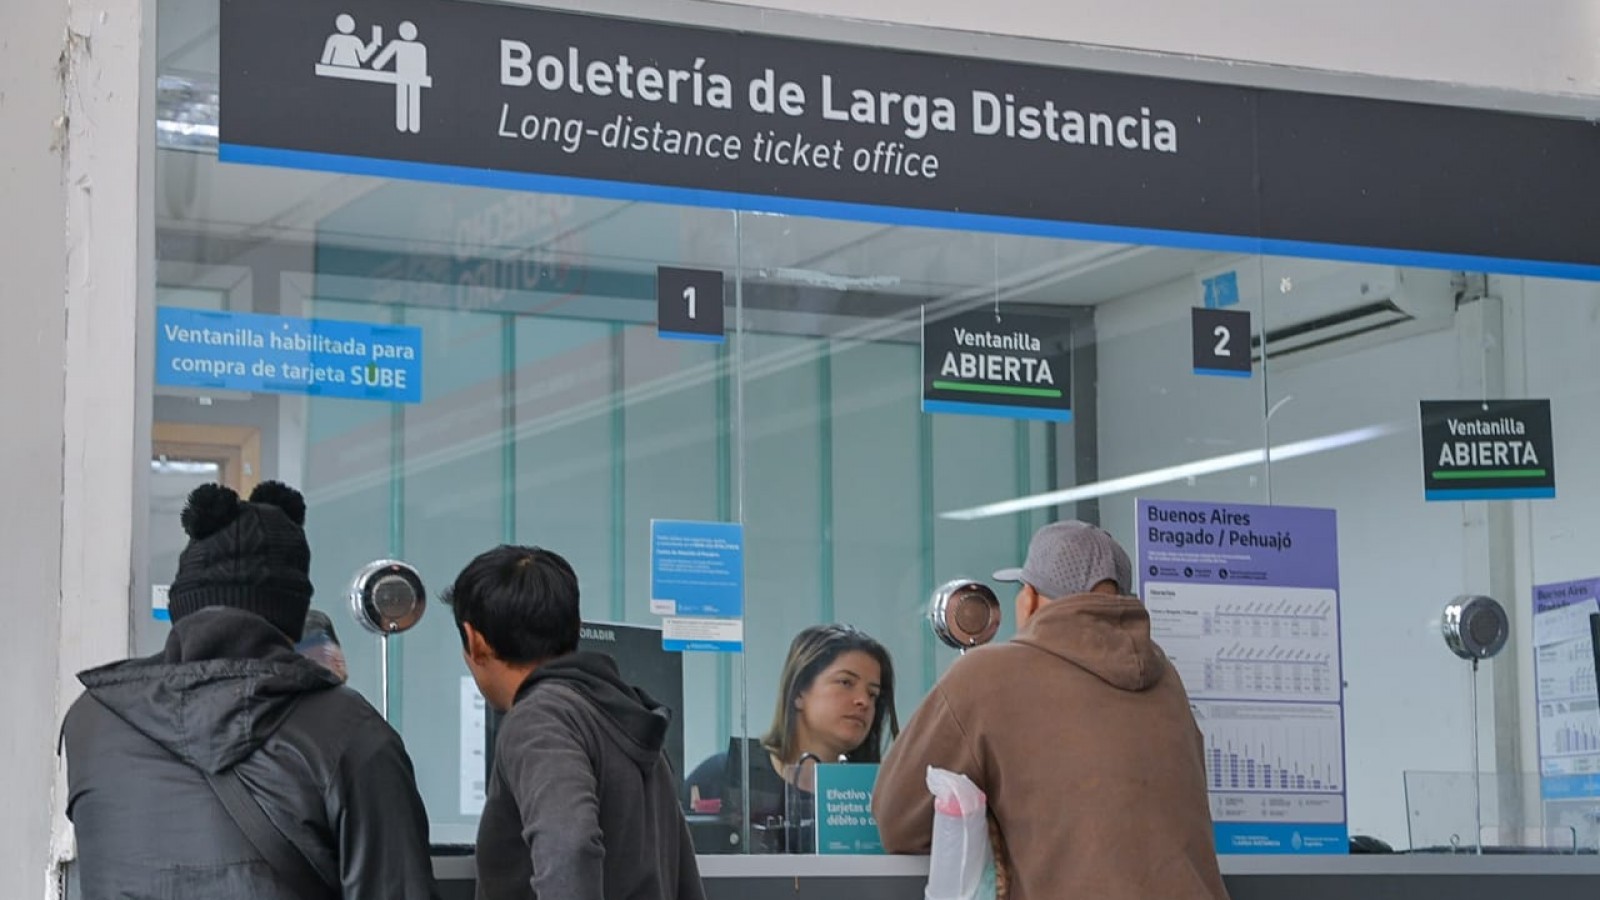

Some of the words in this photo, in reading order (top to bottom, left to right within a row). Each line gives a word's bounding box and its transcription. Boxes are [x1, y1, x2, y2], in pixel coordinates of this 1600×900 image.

[500, 39, 732, 109] Boletería
[749, 69, 806, 115] de
[822, 75, 956, 139] Larga
[972, 90, 1177, 152] Distancia
[498, 103, 742, 160] Long-distance
[753, 131, 842, 170] ticket
[853, 141, 939, 178] office
[683, 286, 696, 319] 1
[164, 324, 264, 349] Ventanilla
[270, 332, 366, 356] habilitada
[372, 341, 415, 361] para
[953, 327, 1041, 352] Ventanilla
[1214, 325, 1231, 357] 2
[171, 356, 246, 379] compra
[252, 360, 276, 378] de
[282, 363, 345, 385] tarjeta
[351, 362, 407, 389] SUBE
[941, 351, 1054, 385] ABIERTA
[1447, 417, 1525, 437] Ventanilla
[1438, 440, 1539, 466] ABIERTA
[1147, 505, 1206, 525] Buenos
[1210, 508, 1250, 527] Aires
[1147, 526, 1214, 548] Bragado
[1218, 529, 1226, 548] /
[1229, 530, 1292, 552] Pehuajó
[580, 627, 616, 641] ORADIR
[826, 788, 866, 801] Efectivo
[826, 801, 864, 814] tarjetas
